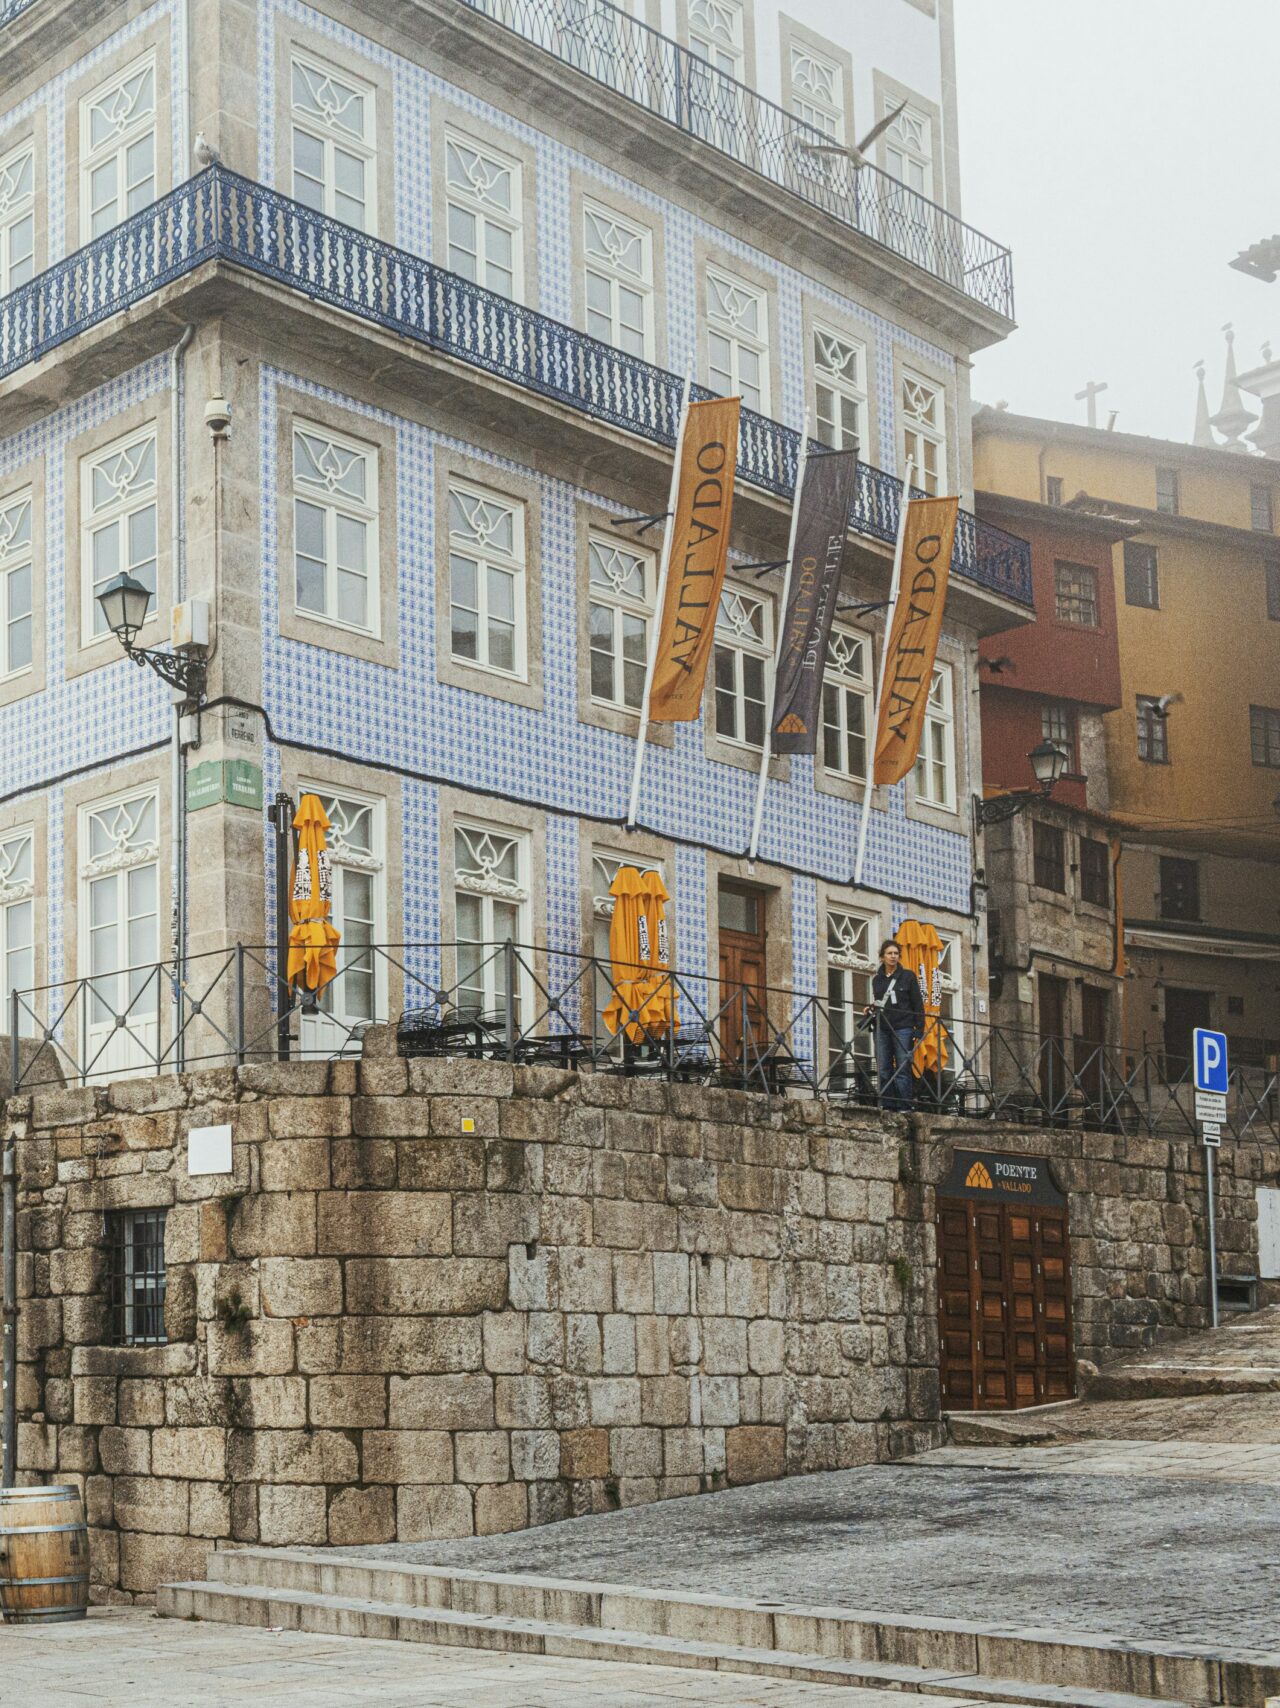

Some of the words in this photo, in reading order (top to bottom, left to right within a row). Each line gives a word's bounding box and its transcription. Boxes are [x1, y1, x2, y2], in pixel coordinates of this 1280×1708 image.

[1203, 1036, 1221, 1085] P
[995, 1162, 1037, 1179] POENTE
[1001, 1180, 1032, 1193] VALLADO
